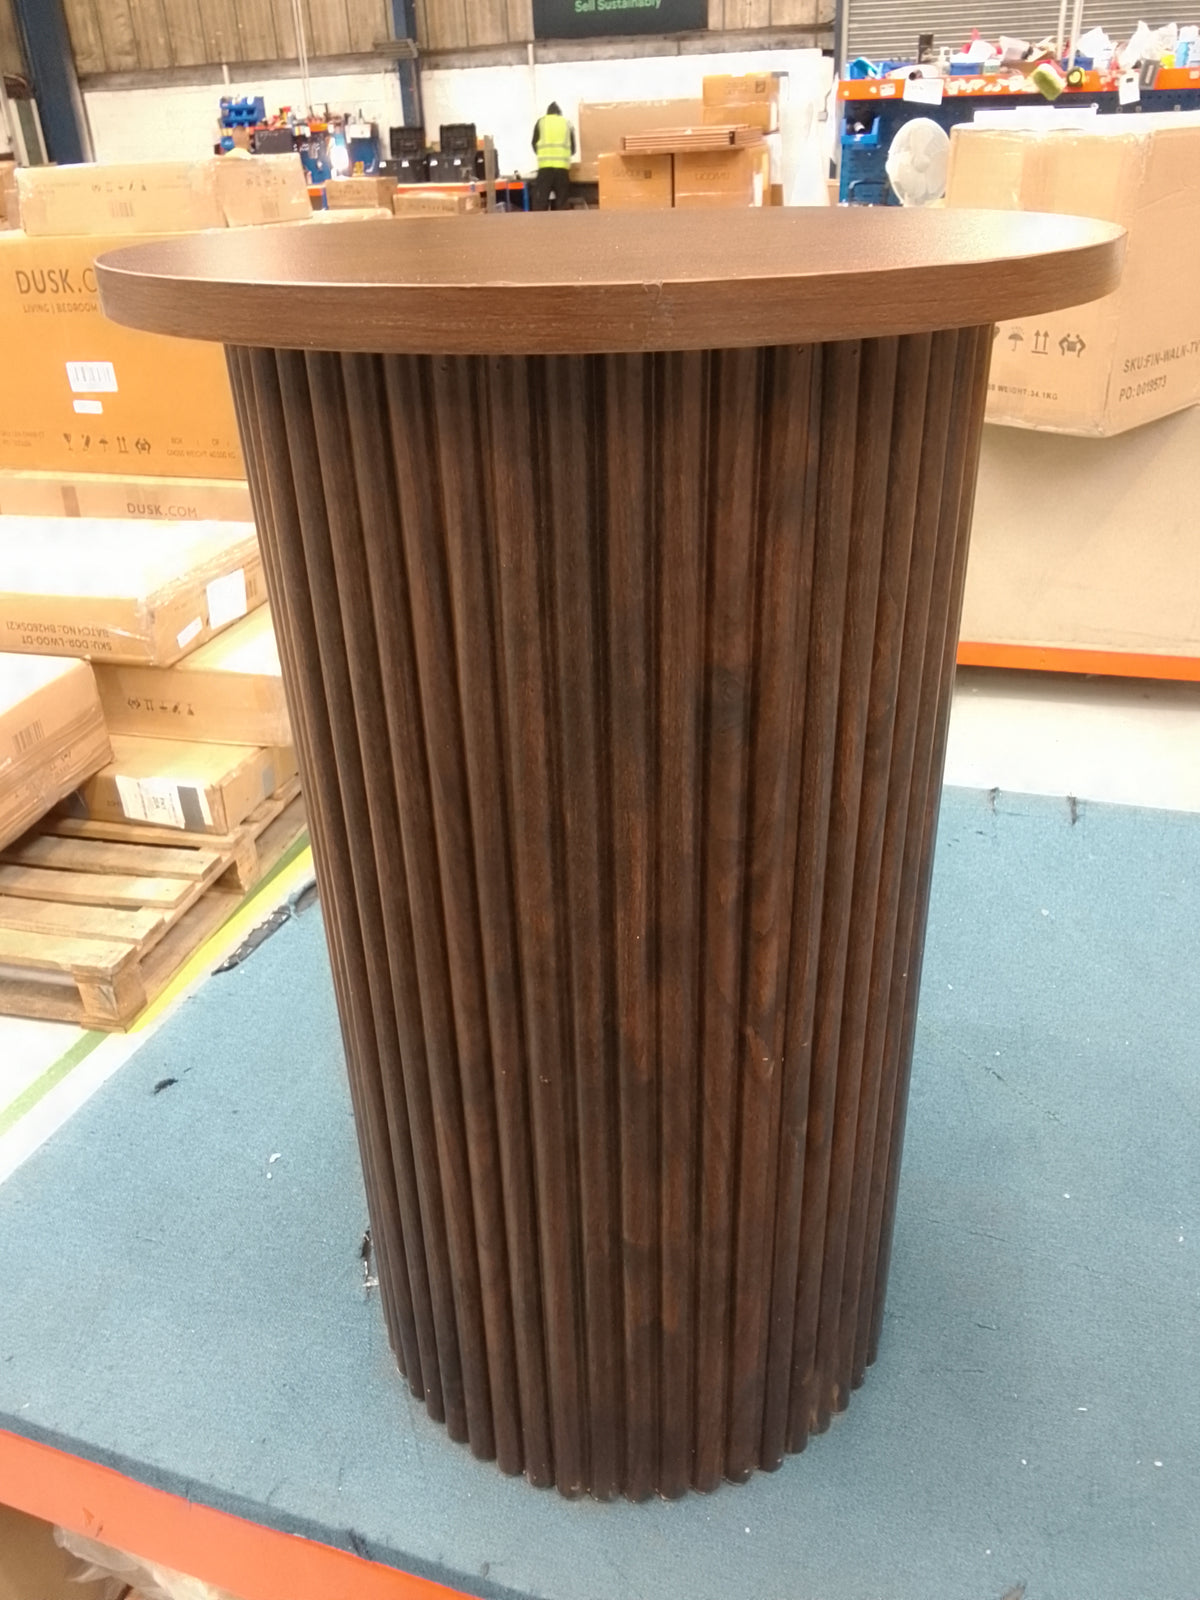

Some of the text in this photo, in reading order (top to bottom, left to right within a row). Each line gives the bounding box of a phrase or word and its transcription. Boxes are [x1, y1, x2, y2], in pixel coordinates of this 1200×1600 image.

[574, 0, 661, 12] Sell Sustainably
[15, 268, 98, 294] DUSK.C
[127, 503, 198, 518] DUSK.COM
